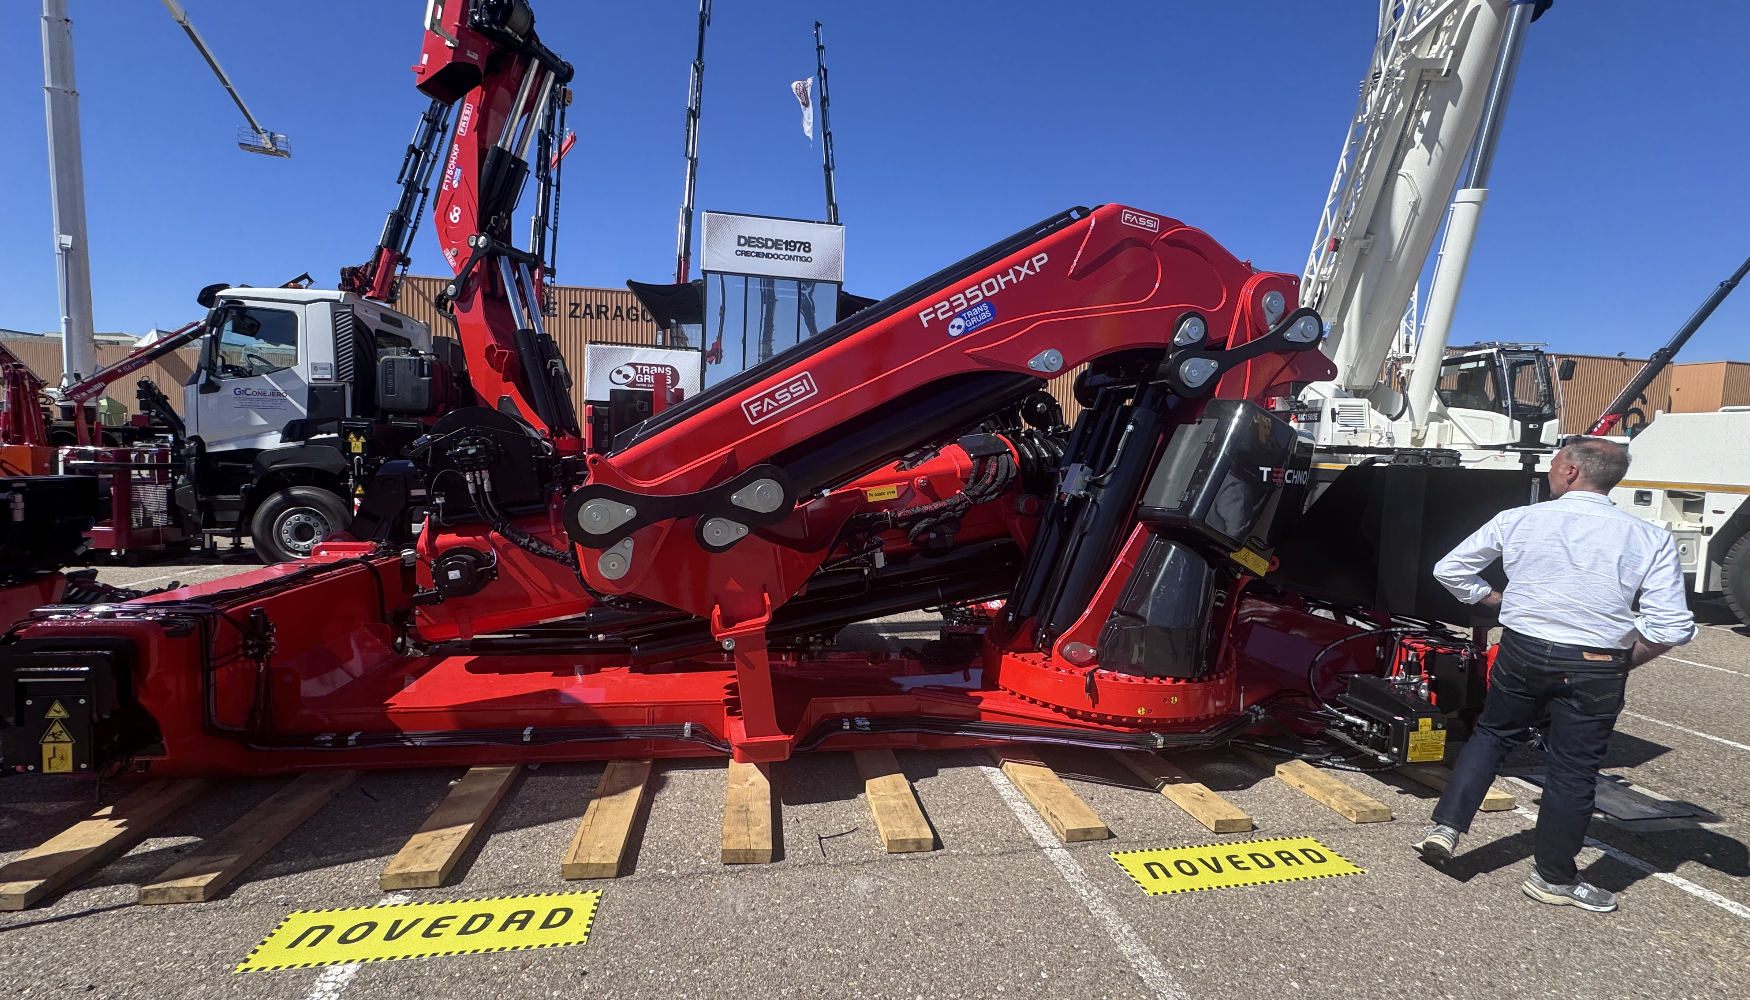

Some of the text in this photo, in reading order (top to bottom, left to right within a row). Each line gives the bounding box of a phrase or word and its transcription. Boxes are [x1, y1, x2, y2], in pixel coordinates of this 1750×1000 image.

[459, 104, 473, 134] FASSI
[1125, 213, 1157, 229] FASSI
[919, 252, 1049, 328] F2350HXP
[749, 378, 811, 417] FASSI
[1142, 848, 1328, 880] NOVEDAD
[285, 907, 574, 949] NOVEDAD
